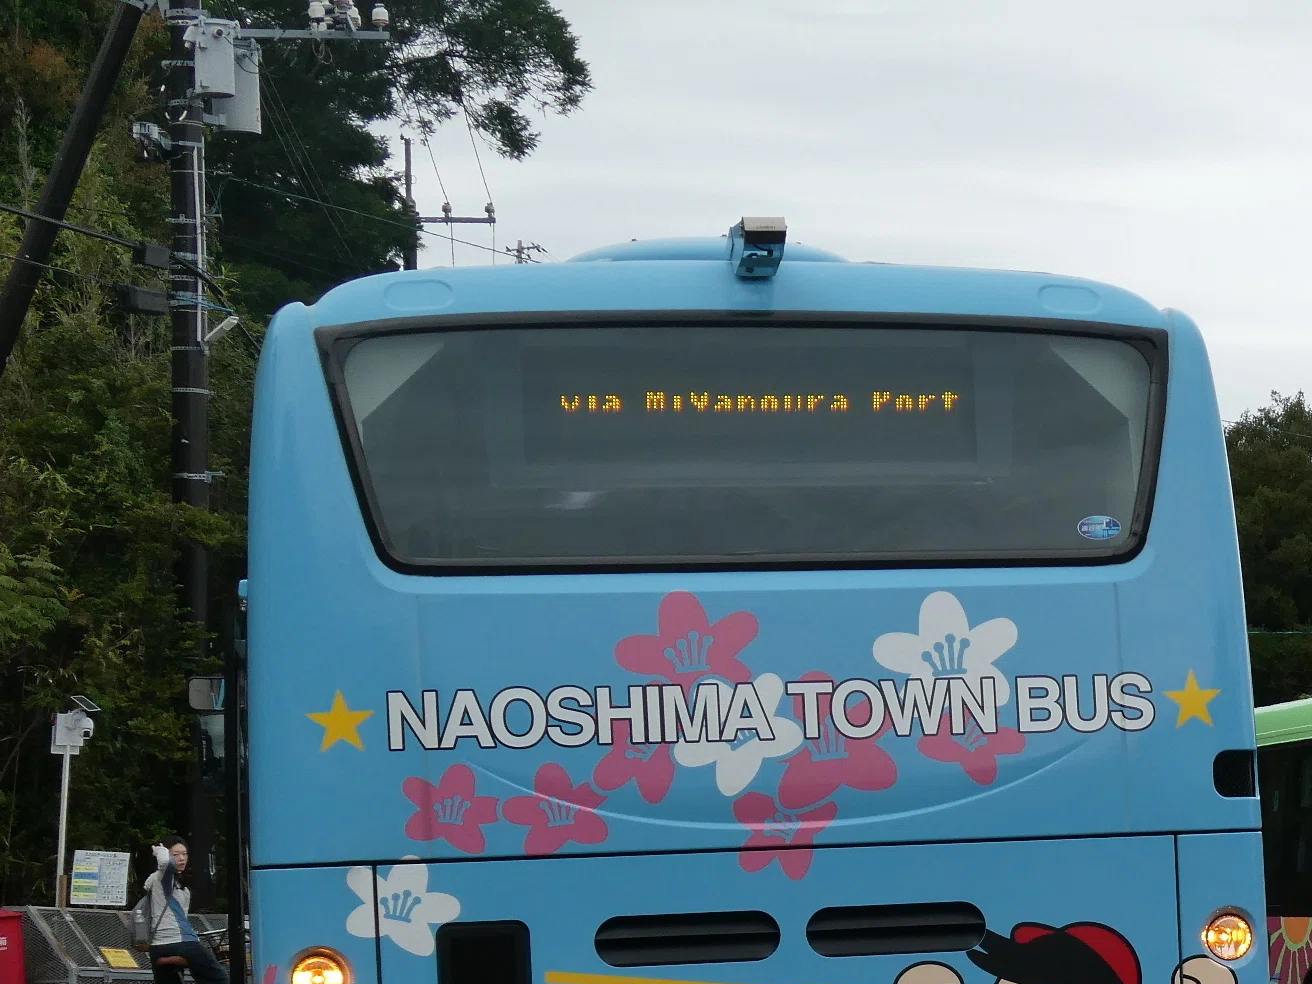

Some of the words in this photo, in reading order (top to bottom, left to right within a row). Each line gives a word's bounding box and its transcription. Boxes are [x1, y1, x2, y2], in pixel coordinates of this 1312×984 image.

[560, 393, 623, 412] via
[386, 682, 776, 751] NAOSHIMA
[785, 673, 999, 741] TOWN
[1015, 671, 1157, 735] BUS
